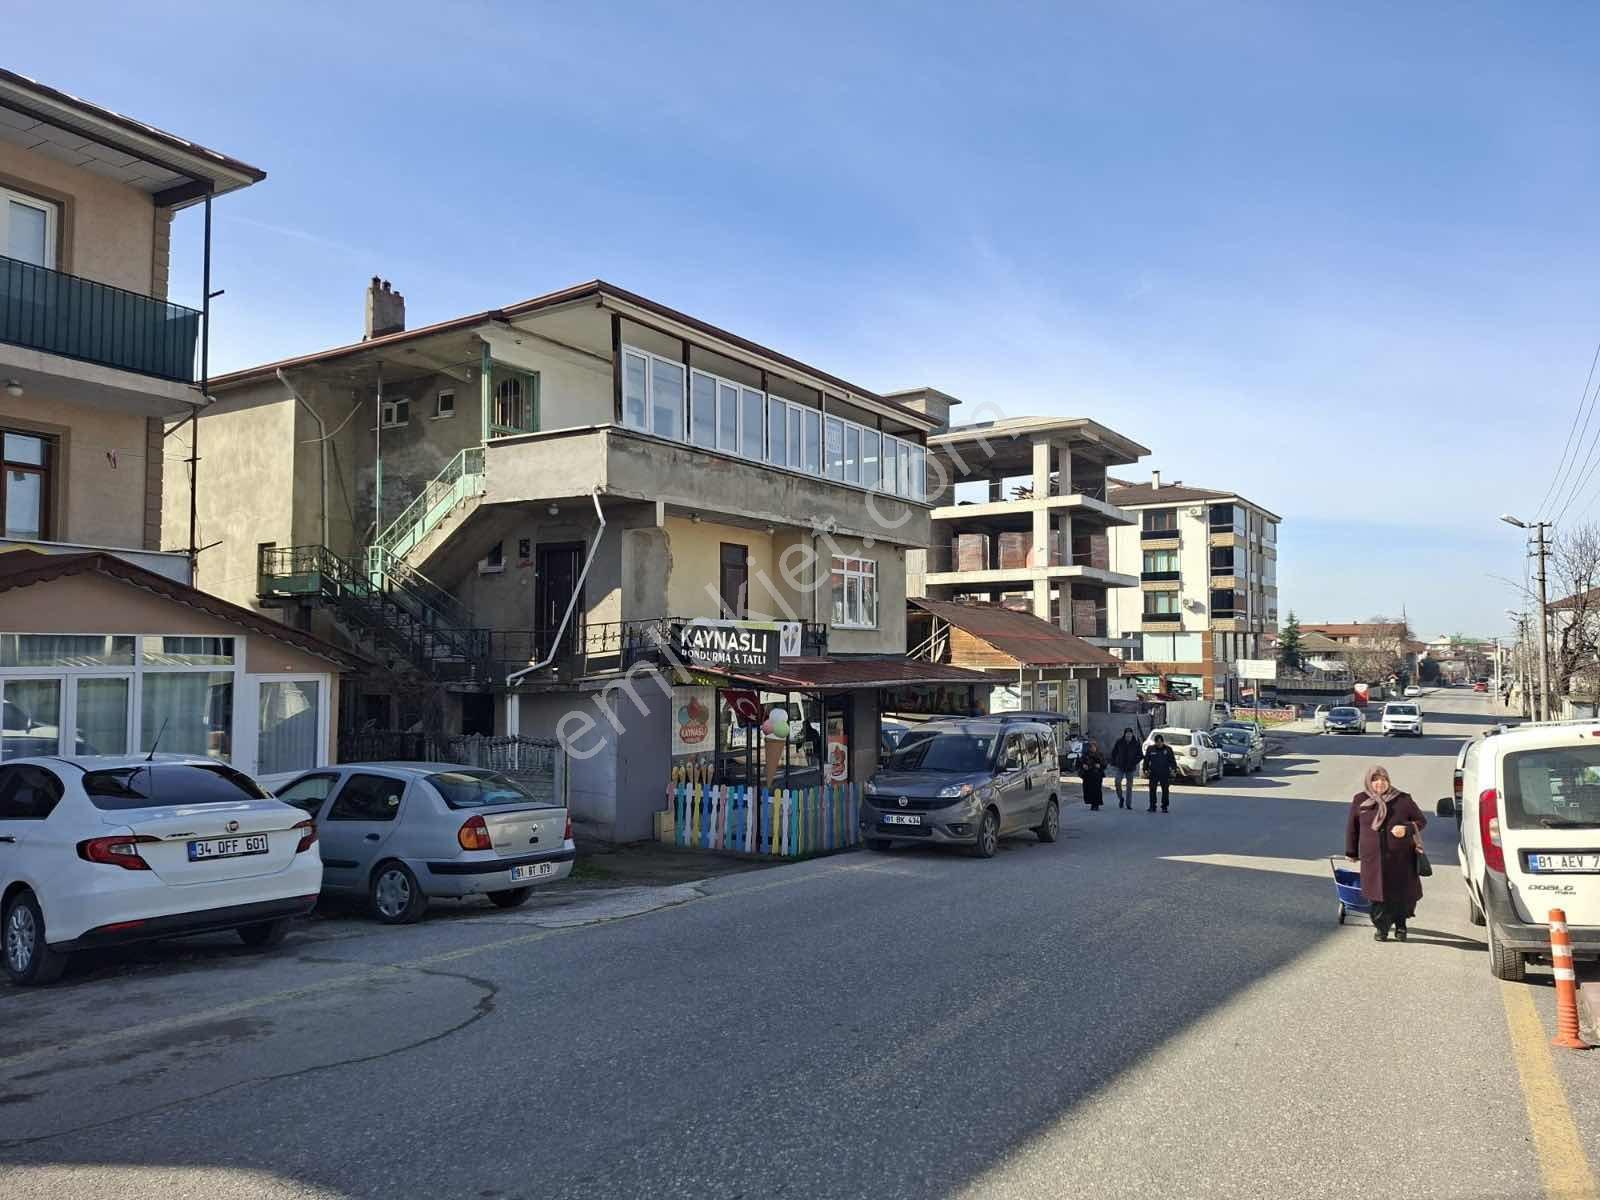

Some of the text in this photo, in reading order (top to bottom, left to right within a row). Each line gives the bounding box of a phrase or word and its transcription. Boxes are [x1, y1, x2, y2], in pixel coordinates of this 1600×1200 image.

[681, 649, 767, 665] DONDURMA & TATLI
[197, 842, 212, 856] 34
[246, 837, 265, 851] 601
[1539, 856, 1552, 868] 81
[1561, 856, 1583, 868] AEV
